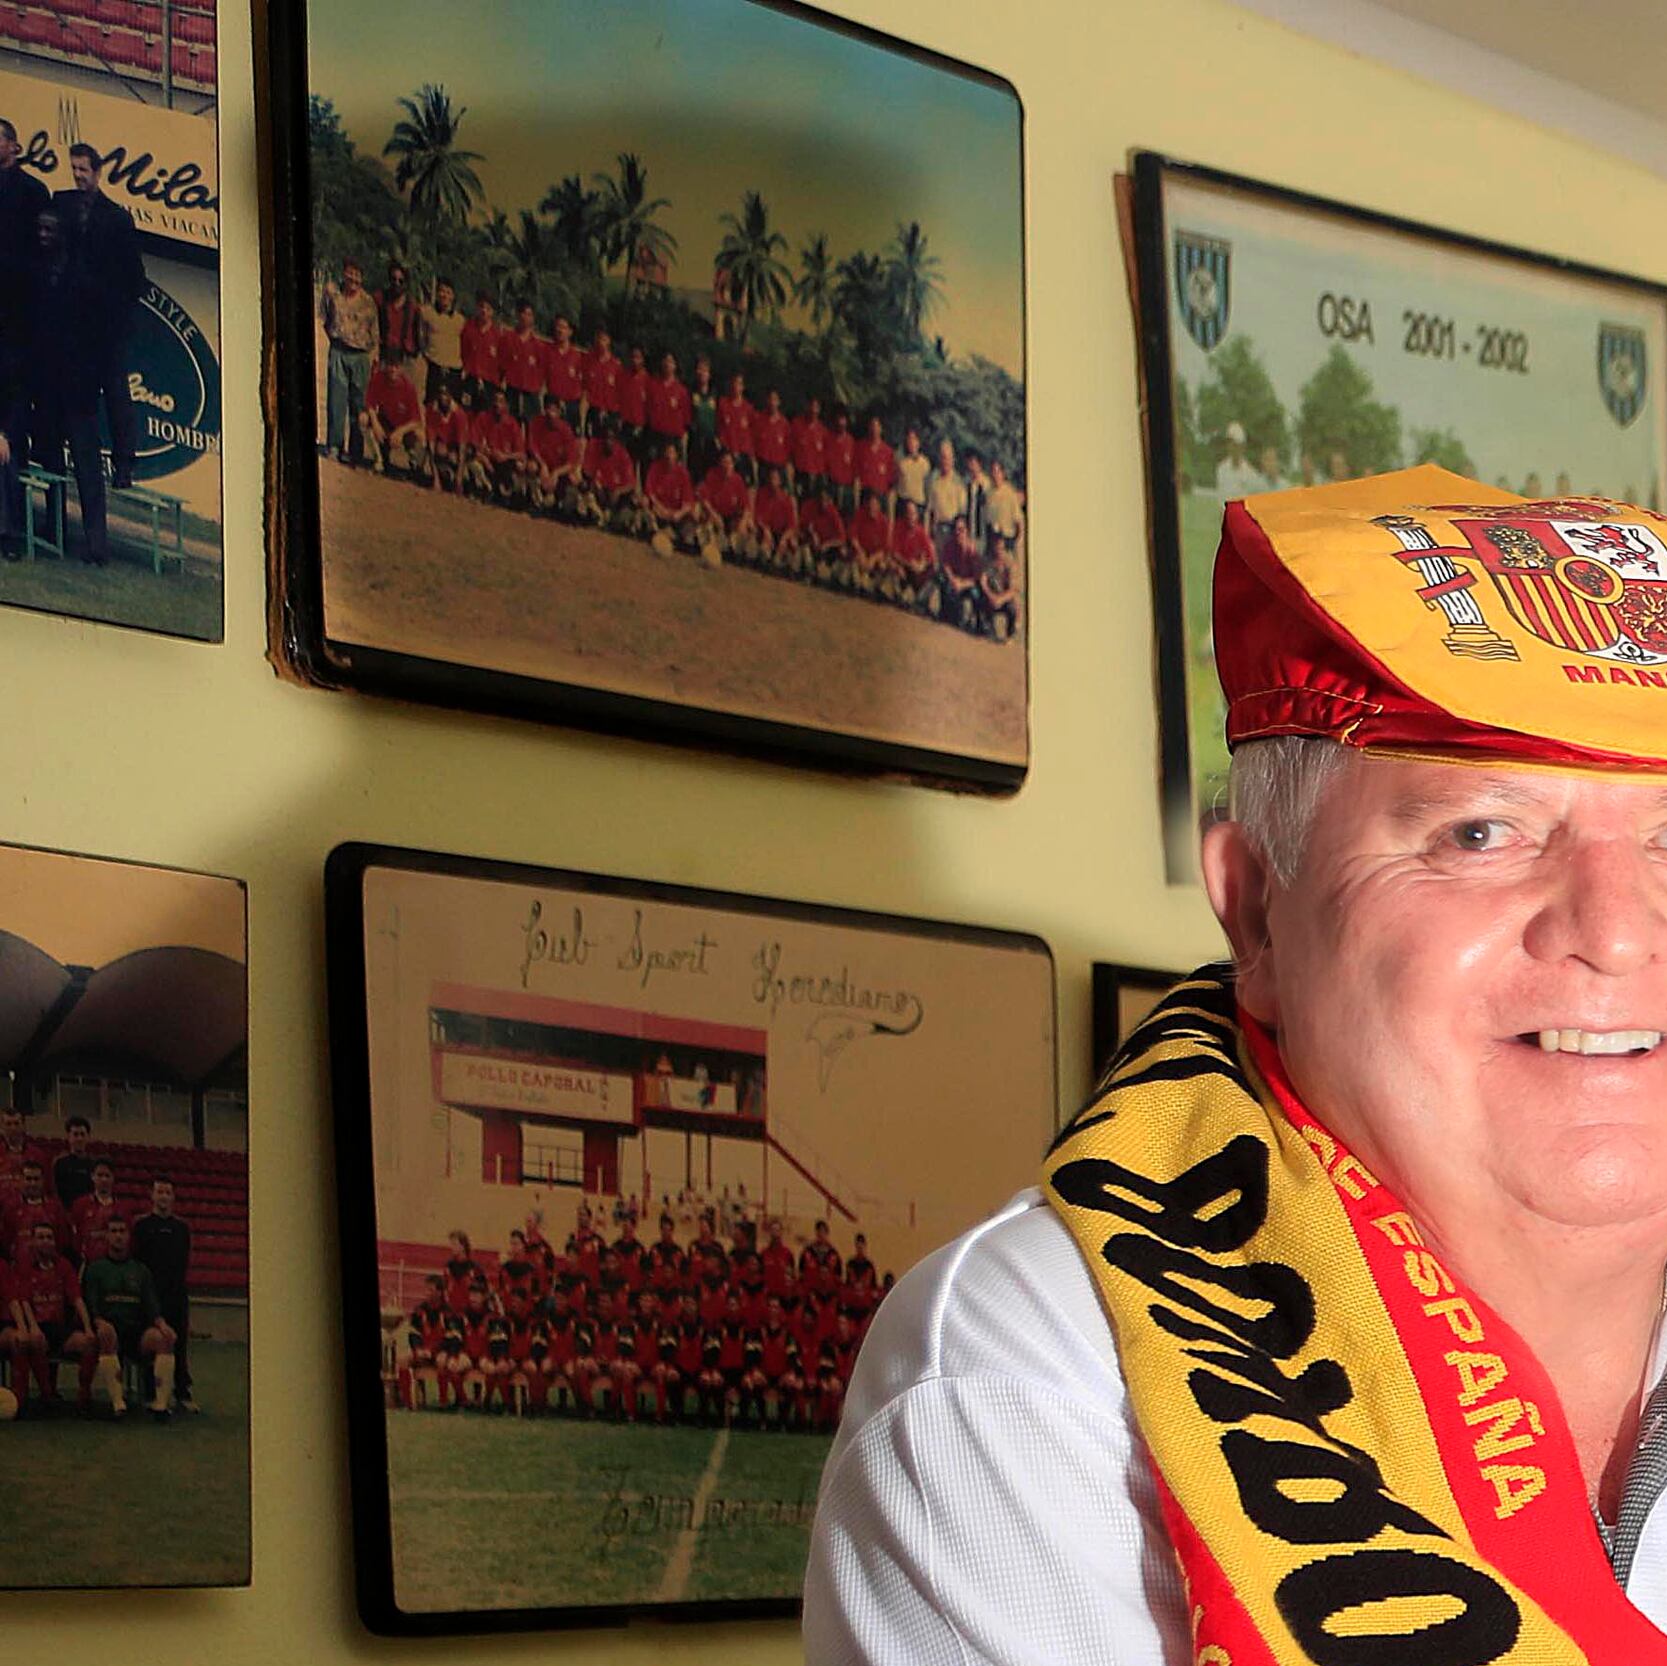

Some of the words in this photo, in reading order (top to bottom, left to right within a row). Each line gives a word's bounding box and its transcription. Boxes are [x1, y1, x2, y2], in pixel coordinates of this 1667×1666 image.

[100, 148, 218, 208] Mila
[1318, 294, 1374, 345] OSA
[1402, 309, 1456, 360] 2001
[1476, 323, 1530, 375] 2002
[1370, 1211, 1547, 1521] ESPAÑA
